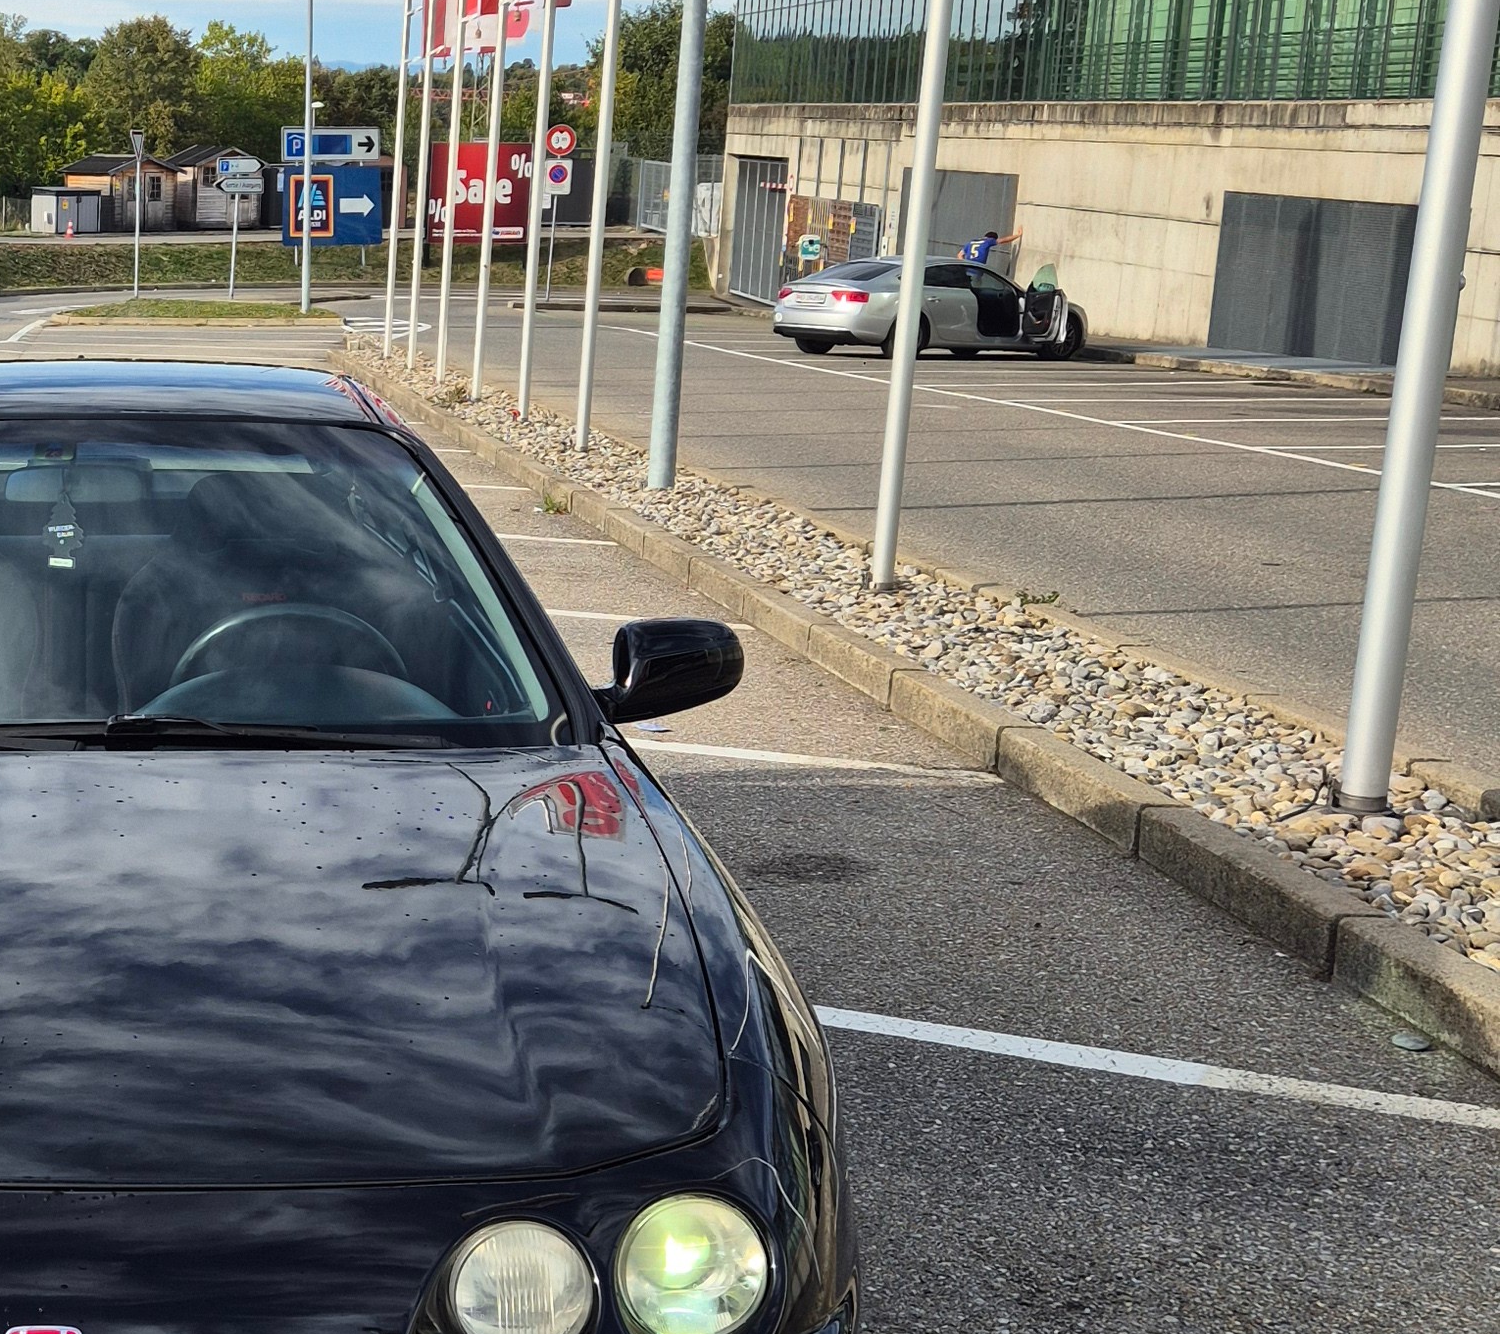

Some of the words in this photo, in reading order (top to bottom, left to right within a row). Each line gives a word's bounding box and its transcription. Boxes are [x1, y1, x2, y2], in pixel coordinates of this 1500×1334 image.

[455, 170, 512, 203] Sae
[297, 209, 326, 221] ADI
[970, 244, 980, 259] 5
